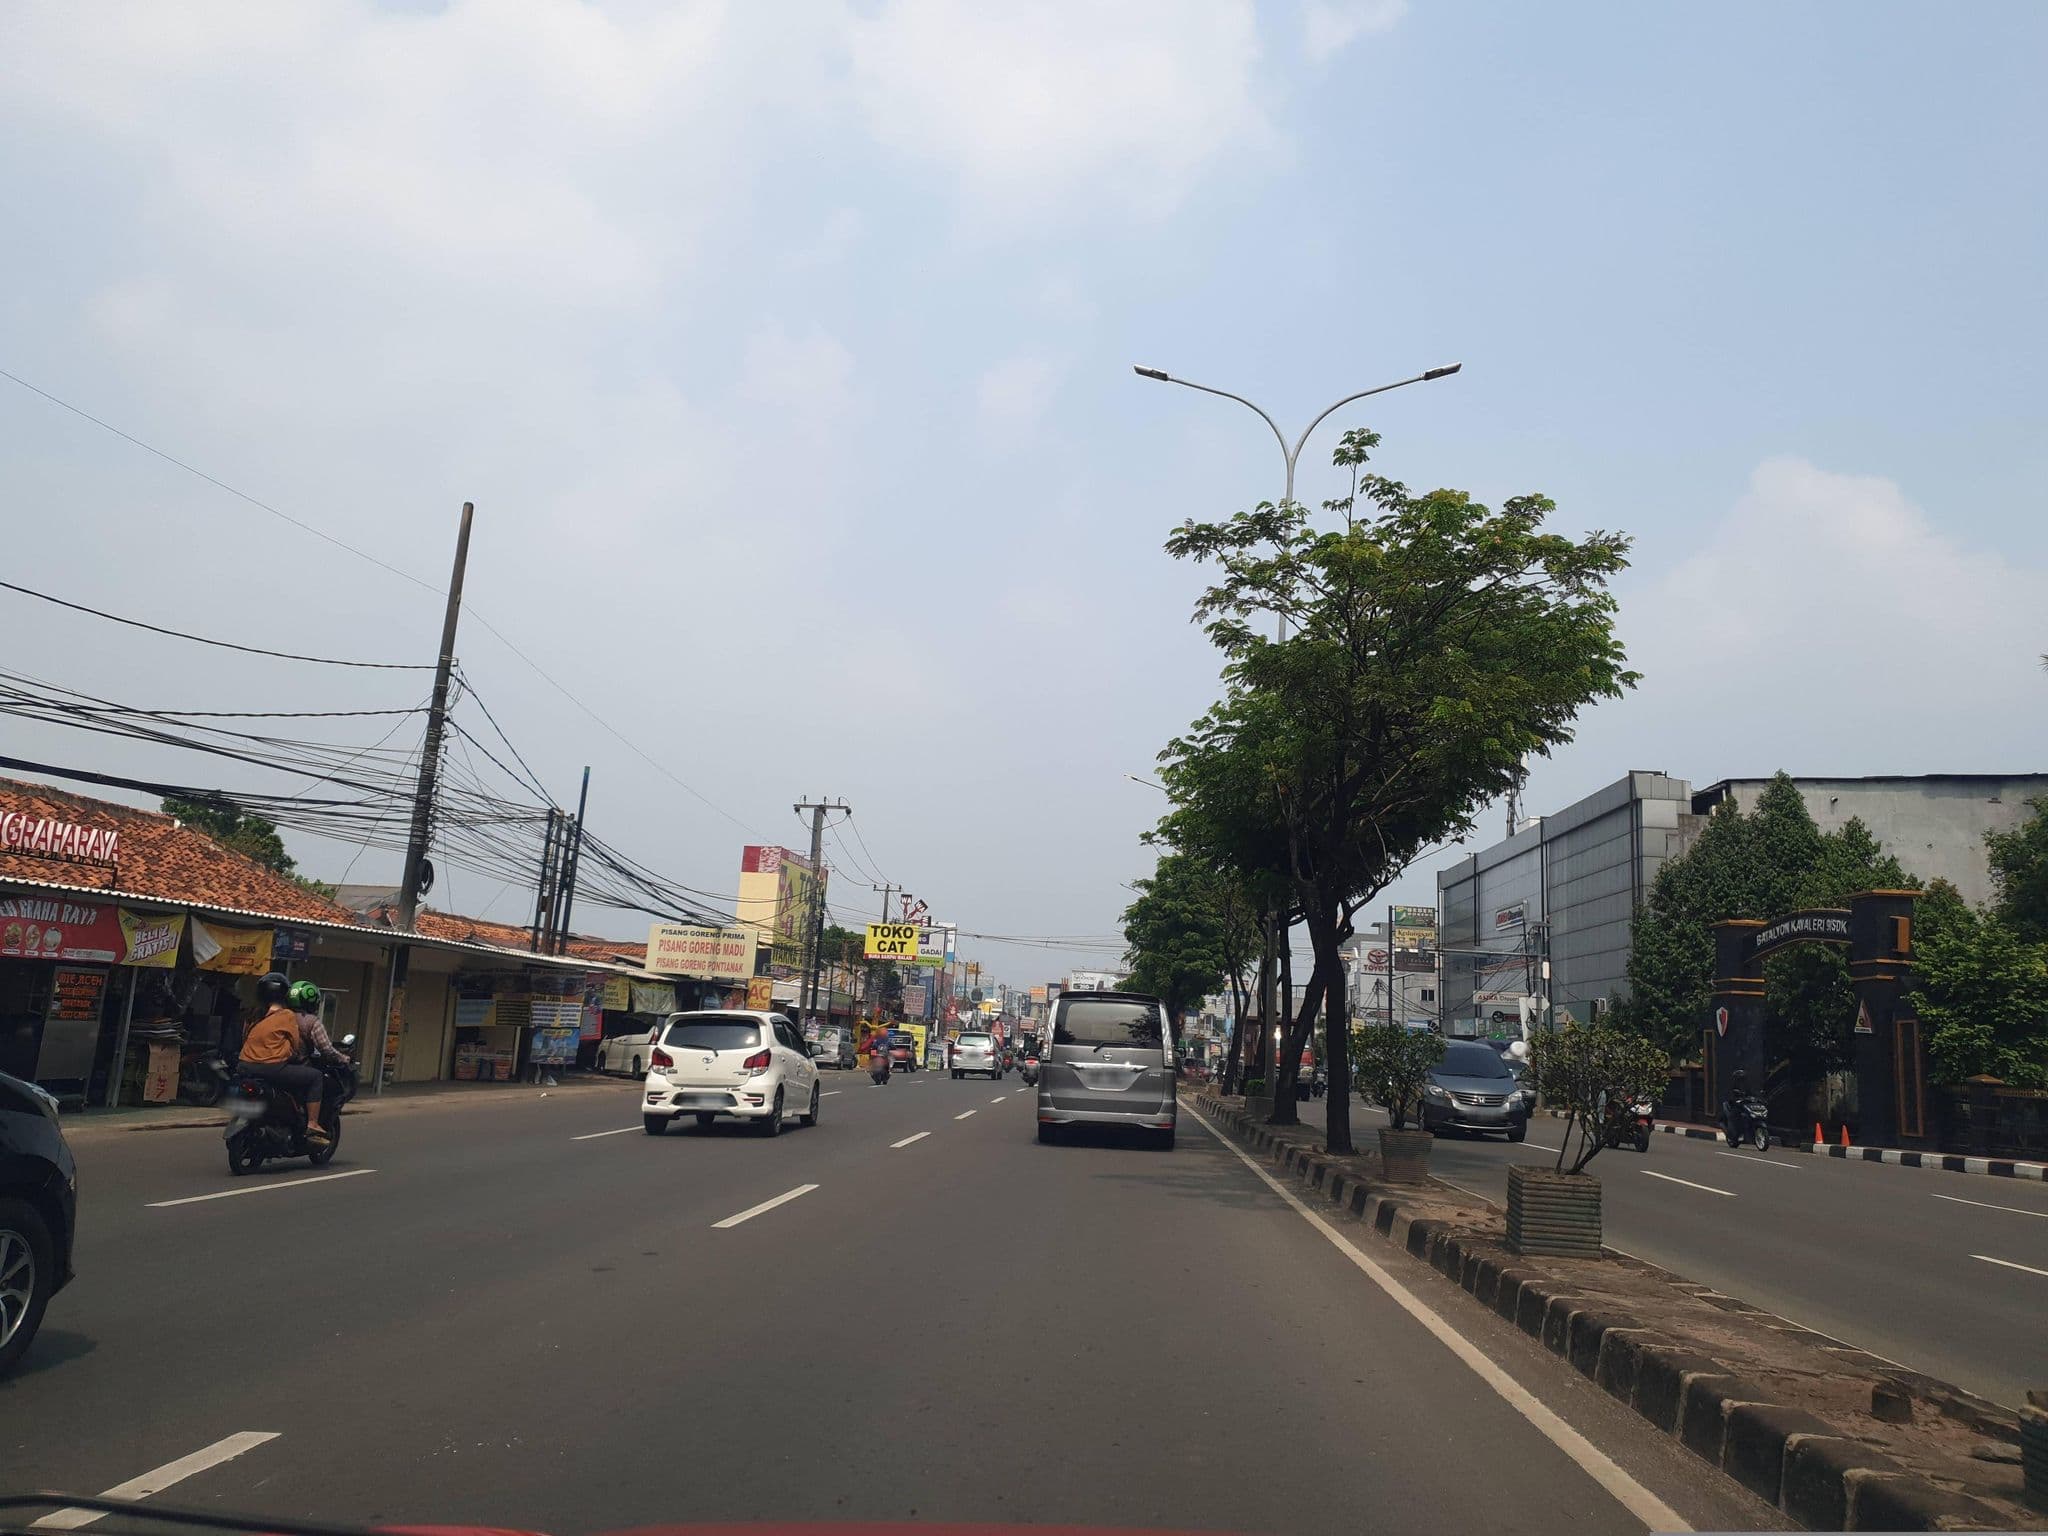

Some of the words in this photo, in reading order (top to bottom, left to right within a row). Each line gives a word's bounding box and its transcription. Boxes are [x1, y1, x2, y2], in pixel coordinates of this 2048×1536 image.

[19, 900, 59, 922] GRAHA
[61, 904, 97, 925] RAYA
[135, 927, 160, 945] BELI
[160, 924, 170, 938] 2
[661, 928, 688, 936] PISANG
[690, 930, 721, 938] GORENG
[722, 932, 745, 940] PRIMA
[871, 925, 914, 939] TOKO
[1757, 923, 1790, 945] BATALYON
[1791, 918, 1825, 933] KAVALERI
[129, 938, 169, 962] GRATIS
[658, 939, 687, 953] PISANG
[689, 941, 721, 955] GORENG
[722, 943, 745, 957] MADU
[877, 940, 907, 953] CAT
[656, 957, 678, 968] PISANG
[680, 959, 706, 970] GORENG
[707, 961, 743, 973] PONTIANAK
[1364, 964, 1389, 972] TOYOT
[748, 984, 770, 1001] AC
